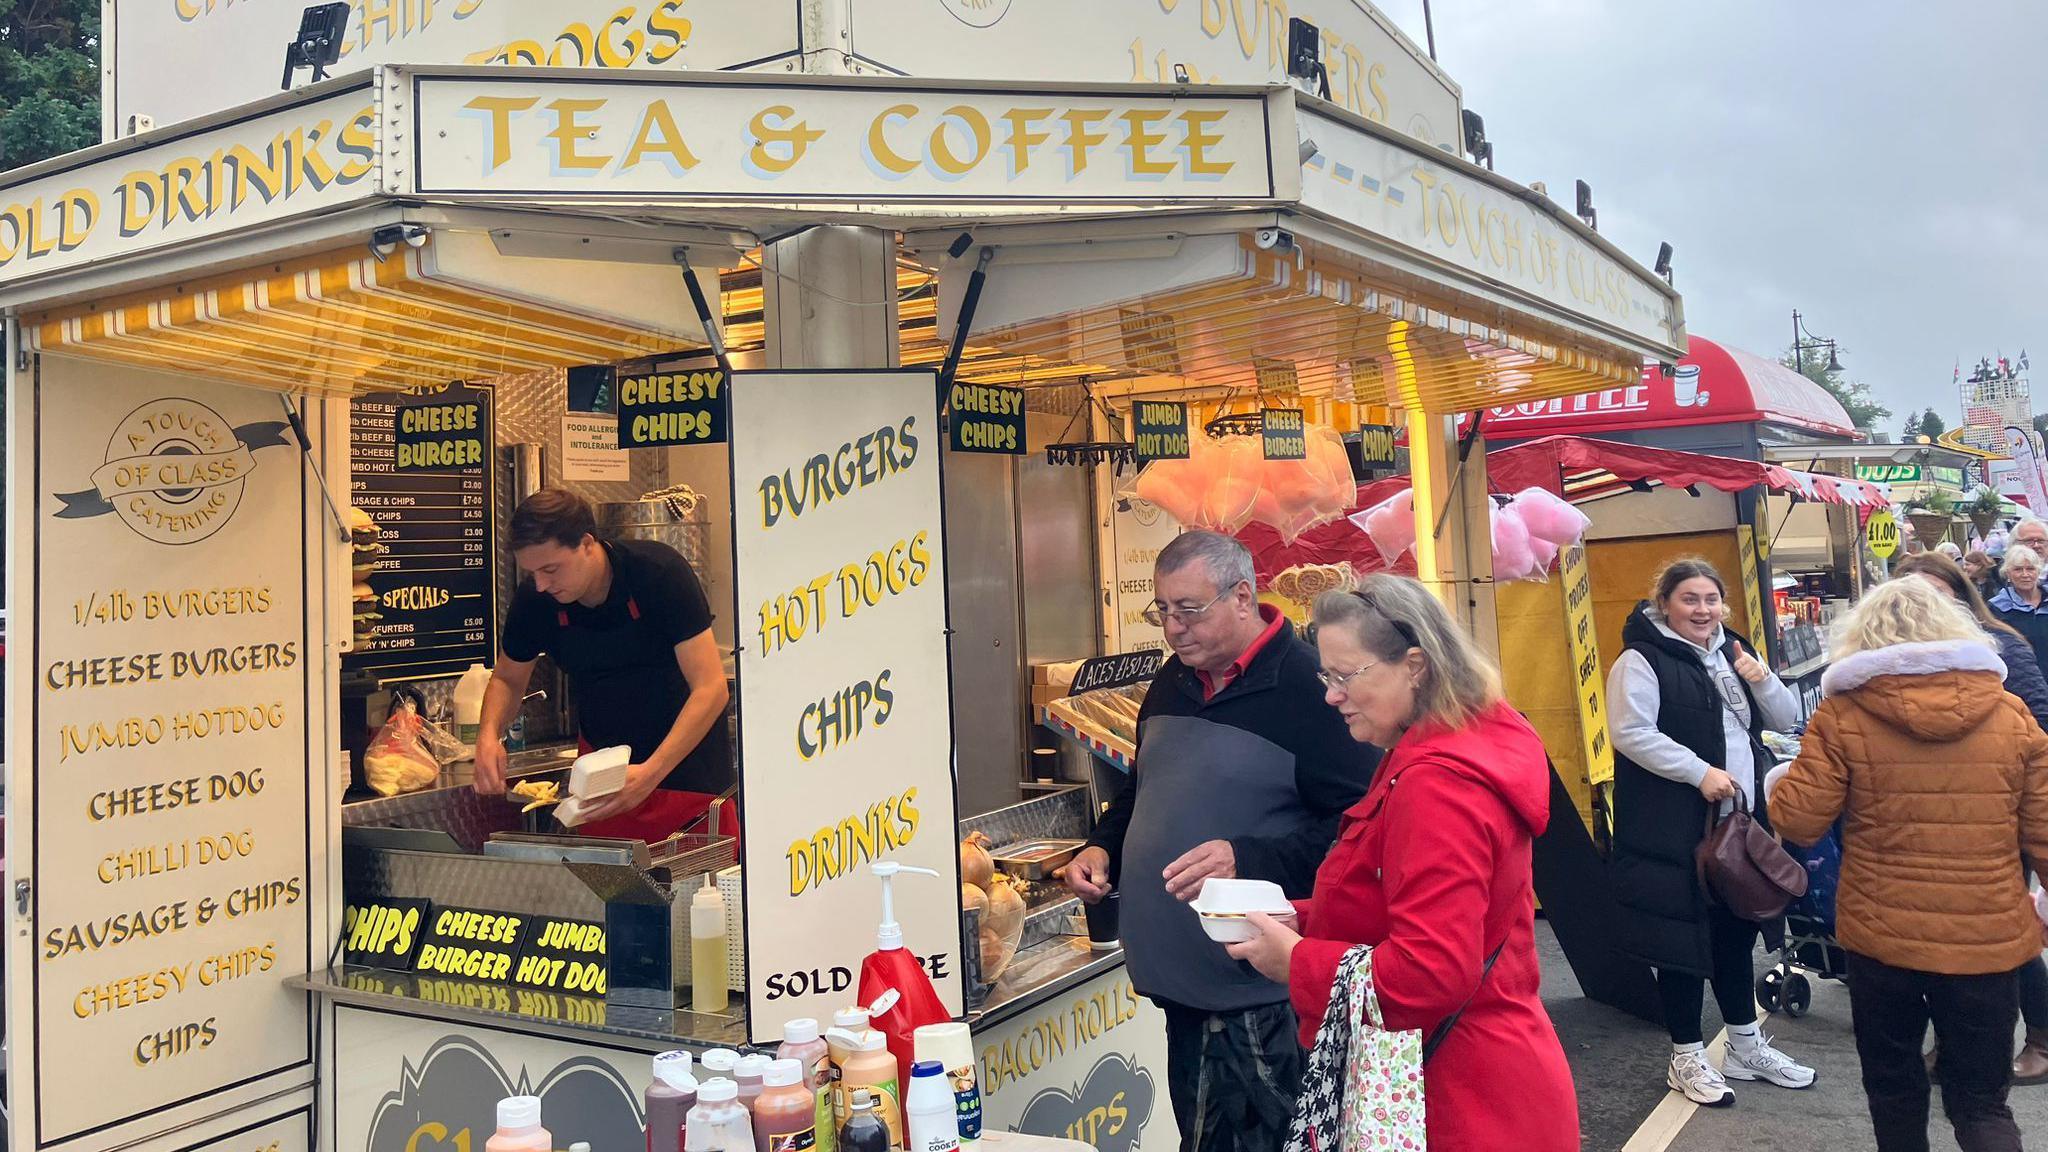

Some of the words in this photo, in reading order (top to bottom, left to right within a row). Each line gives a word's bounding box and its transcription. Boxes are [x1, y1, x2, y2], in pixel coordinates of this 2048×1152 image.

[455, 95, 701, 178] TEA
[741, 105, 826, 181] &
[860, 104, 1236, 182] COFFEE
[113, 105, 375, 238] DRINKS
[1411, 165, 1524, 270] TOUCH
[1531, 229, 1559, 289] OF
[1566, 246, 1631, 322] CLASS
[621, 371, 724, 406] CHEESY
[951, 383, 1024, 416] CHEESY
[361, 418, 394, 428] CHEESE
[362, 403, 382, 412] BEEF
[402, 405, 478, 434] CHEESE
[1140, 403, 1181, 425] JUMBO
[1265, 411, 1301, 431] CHEESE
[127, 432, 146, 452] A
[142, 411, 223, 450] TOUCH
[362, 434, 383, 442] BEEF
[567, 424, 587, 432] FOOD
[632, 410, 712, 443] CHIPS
[961, 421, 1017, 450] CHIPS
[361, 448, 395, 458] CHEESE
[398, 439, 482, 468] BURGER
[570, 441, 622, 451] INTOLERANCE
[1137, 433, 1161, 456] HOT
[1164, 432, 1188, 456] DOG
[1265, 436, 1305, 457] BURGER
[1363, 428, 1395, 462] CHIPS
[114, 463, 152, 488] OF
[158, 457, 238, 486] CLASS
[372, 464, 391, 472] HOT
[758, 415, 919, 530] BURGERS
[463, 481, 482, 489] £3.00
[129, 490, 227, 532] CATERING
[377, 512, 401, 520] CHIPS
[463, 510, 483, 518] £4.50
[383, 497, 390, 506] &
[391, 497, 415, 506] CHIPS
[464, 528, 483, 536] £3.00
[464, 543, 483, 552] £2.00
[1868, 522, 1896, 541] £1.00
[464, 558, 483, 566] £2.50
[143, 584, 274, 620] BURGERS
[383, 586, 450, 610] SPECIALS
[758, 571, 835, 659] HOT
[836, 529, 932, 618] DOGS
[1119, 579, 1147, 594] CHEESE
[1568, 572, 1589, 613] PRIZES
[464, 618, 484, 626] £5.00
[1577, 614, 1588, 645] OFF
[391, 638, 415, 648] CHIPS
[465, 632, 484, 641] £4.50
[46, 652, 163, 692] CHEESE
[170, 641, 297, 680] BURGERS
[1075, 661, 1115, 690] LACES
[1579, 647, 1596, 687] SHELF
[797, 668, 894, 762] CHIPS
[1588, 691, 1598, 718] TO
[59, 714, 166, 764] JUMBO
[1591, 726, 1605, 760] WIN
[87, 777, 202, 823] CHEESE
[207, 767, 265, 801] DOG
[97, 839, 190, 884] CHILLI
[195, 827, 256, 865] DOG
[786, 786, 920, 898] DRINKS
[44, 900, 188, 961] SAUSAGE
[197, 896, 219, 927] &
[224, 876, 301, 920] CHIPS
[435, 909, 522, 944] CHEESE
[417, 944, 513, 980] BURGER
[516, 955, 565, 988] HOT
[73, 961, 193, 1019] CHEESY
[198, 941, 277, 987] CHIPS
[765, 966, 852, 1001] SOLD
[133, 1016, 218, 1068] CHIPS
[980, 1006, 1067, 1096] BACON
[1071, 981, 1140, 1050] ROLLS
